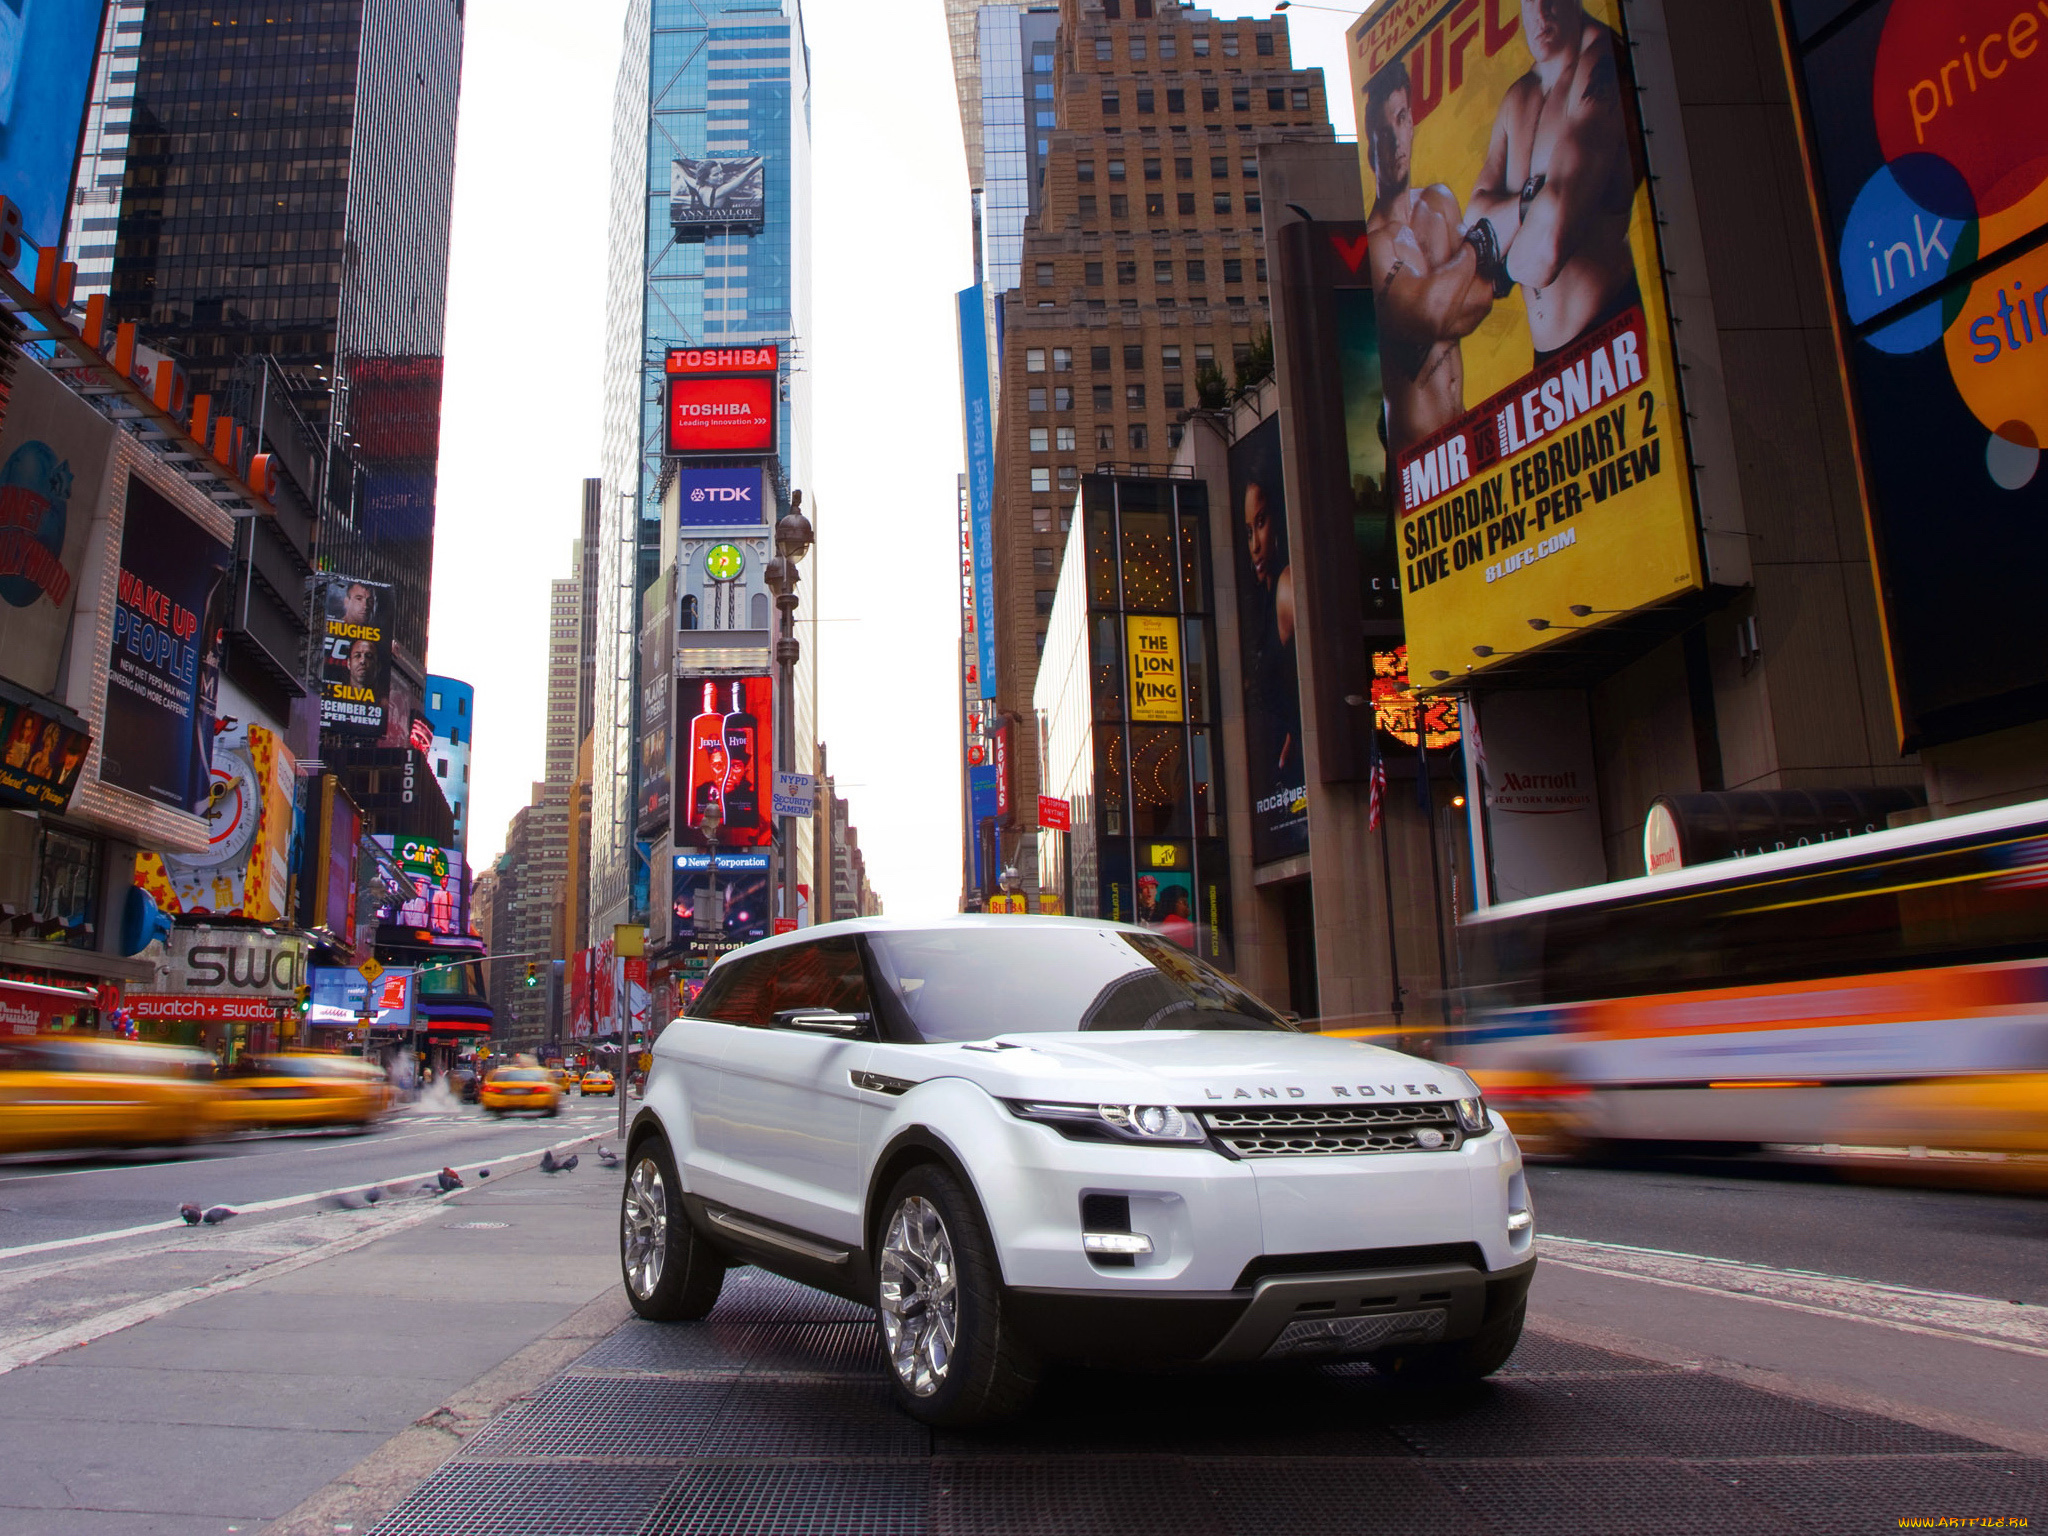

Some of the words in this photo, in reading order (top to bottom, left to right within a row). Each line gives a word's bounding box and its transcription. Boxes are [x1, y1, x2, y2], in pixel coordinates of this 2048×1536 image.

[1412, 0, 1521, 126] UFC
[708, 208, 753, 216] TAYLOR
[1867, 213, 1950, 297] ink
[671, 349, 772, 367] TOSHIBA
[1496, 409, 1509, 458] BROCK
[1504, 330, 1644, 454] LESNAR
[679, 403, 752, 416] TOSHIBA
[679, 419, 709, 428] Leading
[711, 418, 752, 426] Innovation
[972, 397, 986, 457] Market
[1475, 429, 1496, 460] VS
[976, 457, 990, 512] Select
[1402, 466, 1412, 510] FRANK
[1410, 434, 1470, 508] MIR
[1404, 474, 1508, 560] SATURDAY,
[1511, 403, 1627, 507] FEBRUARY
[1638, 390, 1657, 440] 2
[704, 488, 752, 501] TDK
[1407, 557, 1450, 594] LIVE
[1453, 533, 1483, 572] ON
[1487, 439, 1661, 556] PAY-PER-VIEW
[979, 514, 993, 570] Global
[1485, 527, 1577, 584] 81.UFC.COM
[118, 567, 171, 627] WAKE
[172, 603, 197, 641] UP
[981, 571, 995, 645] NASDAQ
[329, 621, 381, 642] HUGHES
[1139, 635, 1168, 650] THE
[112, 604, 197, 686] PEOPLE
[985, 650, 996, 680] The
[1135, 654, 1174, 679] LION
[120, 658, 134, 675] NEW
[133, 665, 147, 681] DIET
[147, 672, 163, 691] PEPSI
[162, 680, 177, 696] MAX
[175, 686, 190, 704] WITH
[133, 681, 147, 699] AND
[146, 687, 163, 706] MORE
[333, 684, 376, 703] SILVA
[645, 673, 668, 709] PLANET
[1135, 681, 1177, 706] KING
[367, 705, 383, 718] 29
[698, 737, 722, 750] JEKYLL
[729, 736, 747, 747] HYDE
[402, 750, 415, 804] 1500
[780, 774, 809, 786] NYPD
[1501, 771, 1578, 792] Marriott
[773, 793, 812, 806] SECURITY
[774, 802, 809, 815] CAMERA
[1517, 795, 1543, 805] YORK
[1546, 795, 1591, 806] MARQUIS
[715, 857, 766, 869] Corporation
[1151, 845, 1177, 867] MTV
[186, 942, 308, 991] swat
[137, 1000, 205, 1016] swatch
[1204, 1086, 1306, 1100] LAND
[1331, 1083, 1444, 1097] ROVER
